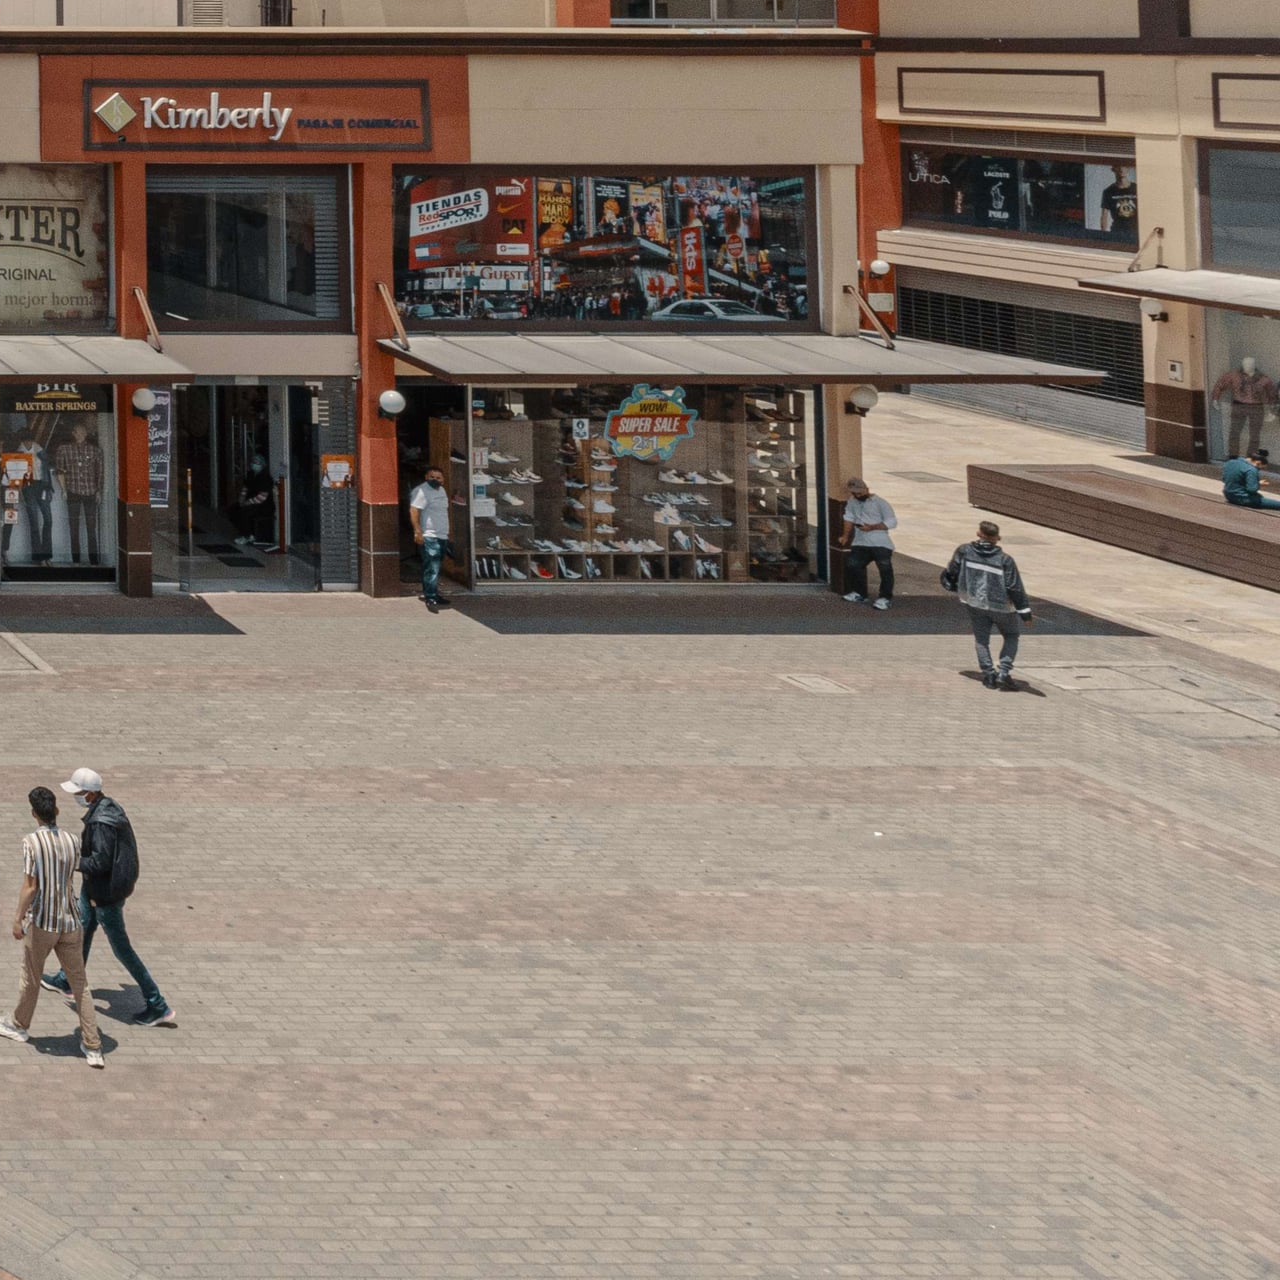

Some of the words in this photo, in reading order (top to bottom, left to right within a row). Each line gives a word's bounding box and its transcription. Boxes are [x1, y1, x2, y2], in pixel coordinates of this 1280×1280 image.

[140, 92, 292, 140] Kimberly
[347, 118, 420, 129] COMERCIAL
[416, 191, 482, 214] TIENDAS
[543, 204, 569, 217] HARD
[480, 266, 523, 279] GUEST
[5, 291, 47, 308] mejor
[52, 291, 97, 307] horma
[15, 401, 54, 411] BAXTER
[55, 401, 97, 411] SPRINGS
[640, 402, 668, 413] WOW!
[618, 417, 651, 433] SUPER
[653, 417, 681, 433] SALE
